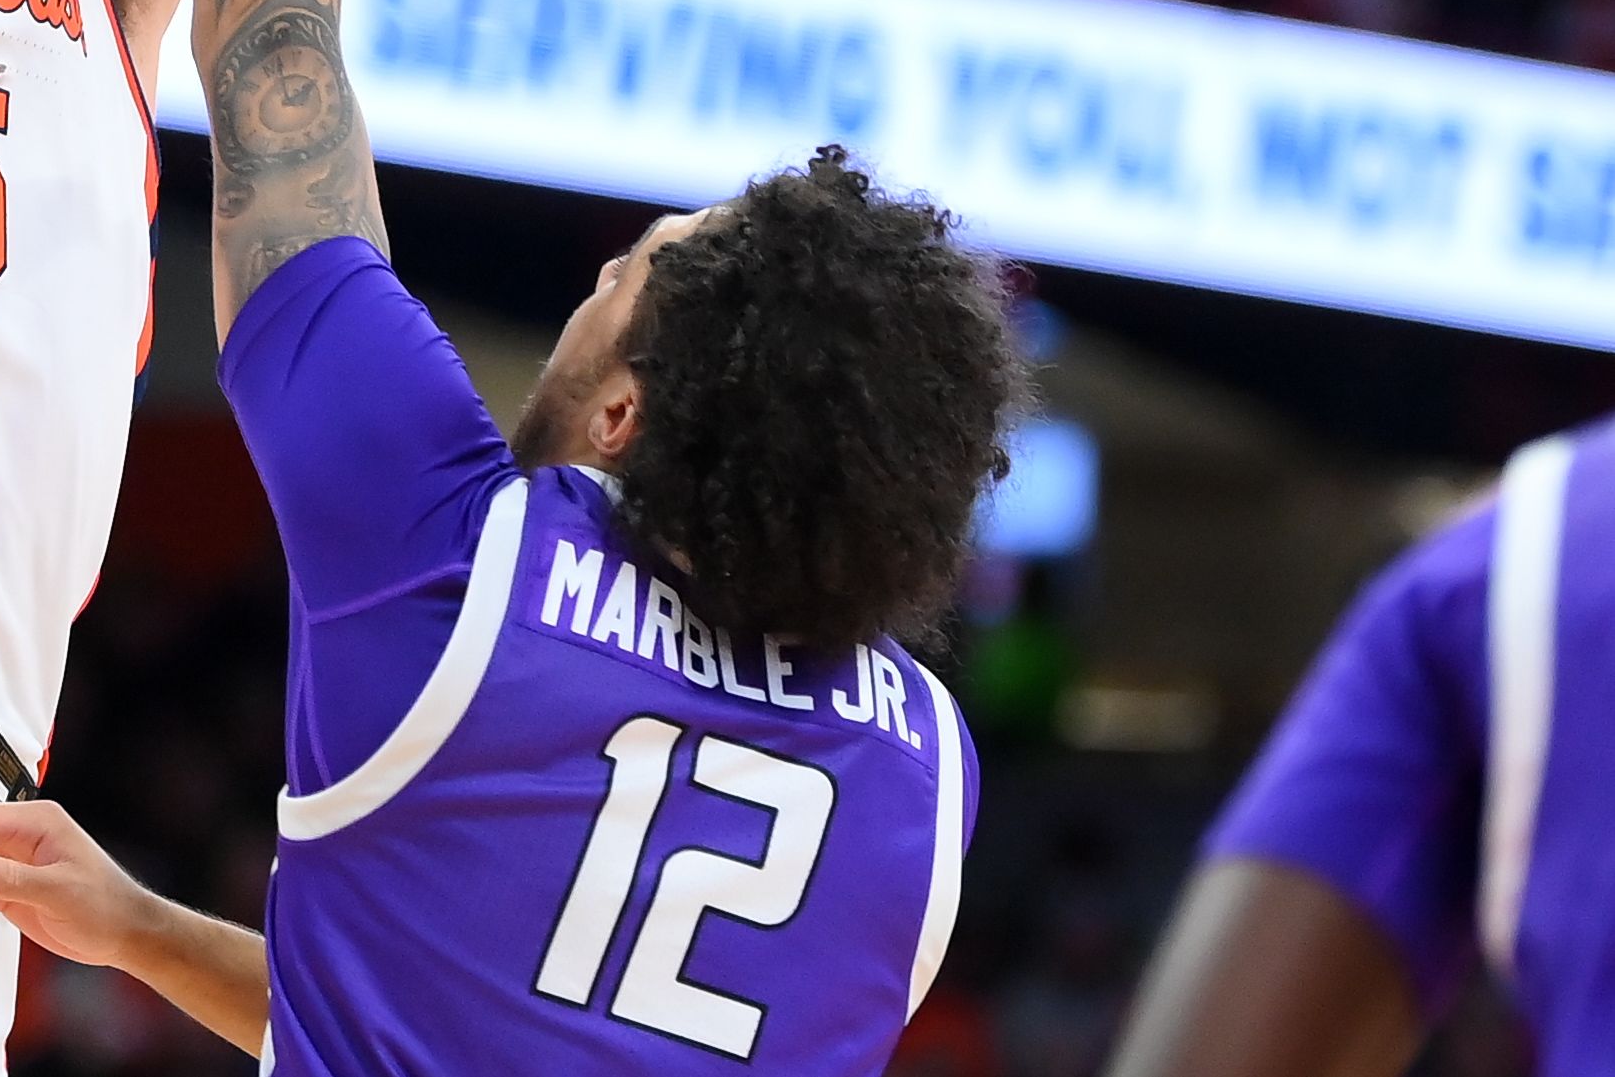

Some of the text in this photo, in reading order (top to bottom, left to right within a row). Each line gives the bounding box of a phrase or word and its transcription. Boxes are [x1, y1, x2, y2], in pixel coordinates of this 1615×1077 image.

[1248, 100, 1472, 236] NOT
[539, 538, 924, 751] MARBLE JR.
[531, 712, 838, 1064] 12
